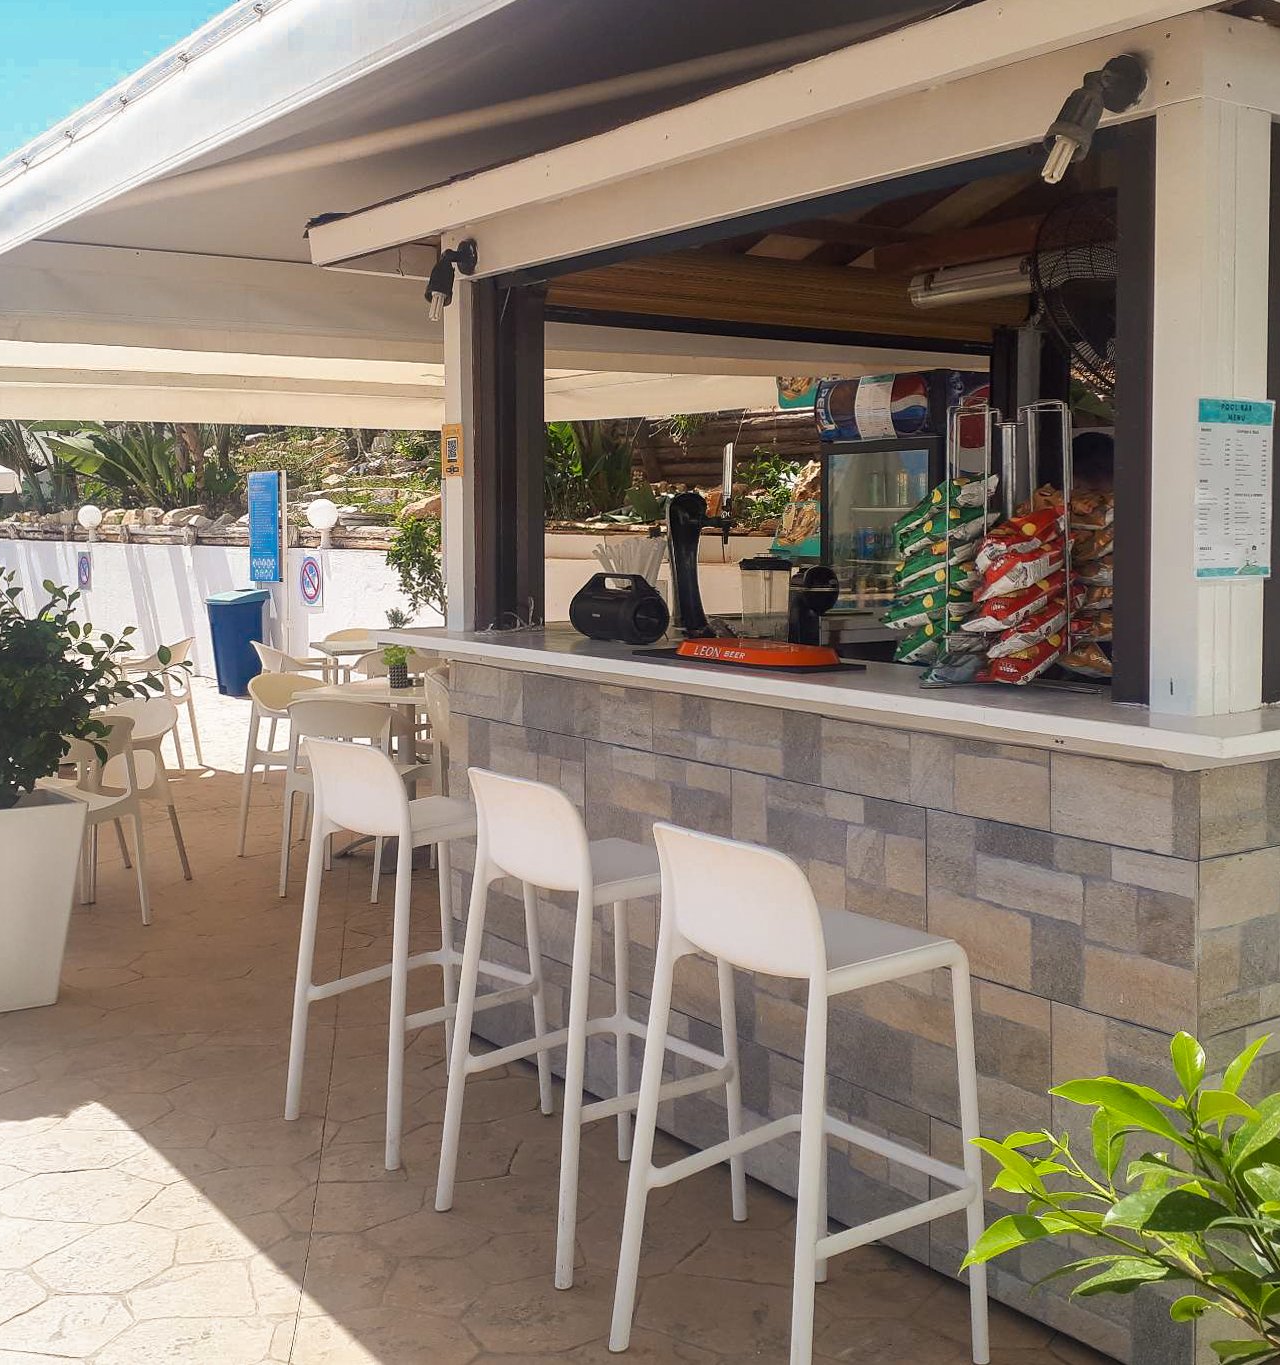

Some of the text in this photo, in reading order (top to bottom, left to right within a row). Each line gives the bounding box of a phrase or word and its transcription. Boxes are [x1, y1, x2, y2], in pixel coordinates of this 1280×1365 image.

[1221, 403, 1238, 411] POOL
[1228, 413, 1246, 421] MENU
[693, 645, 746, 660] LEON BEER
